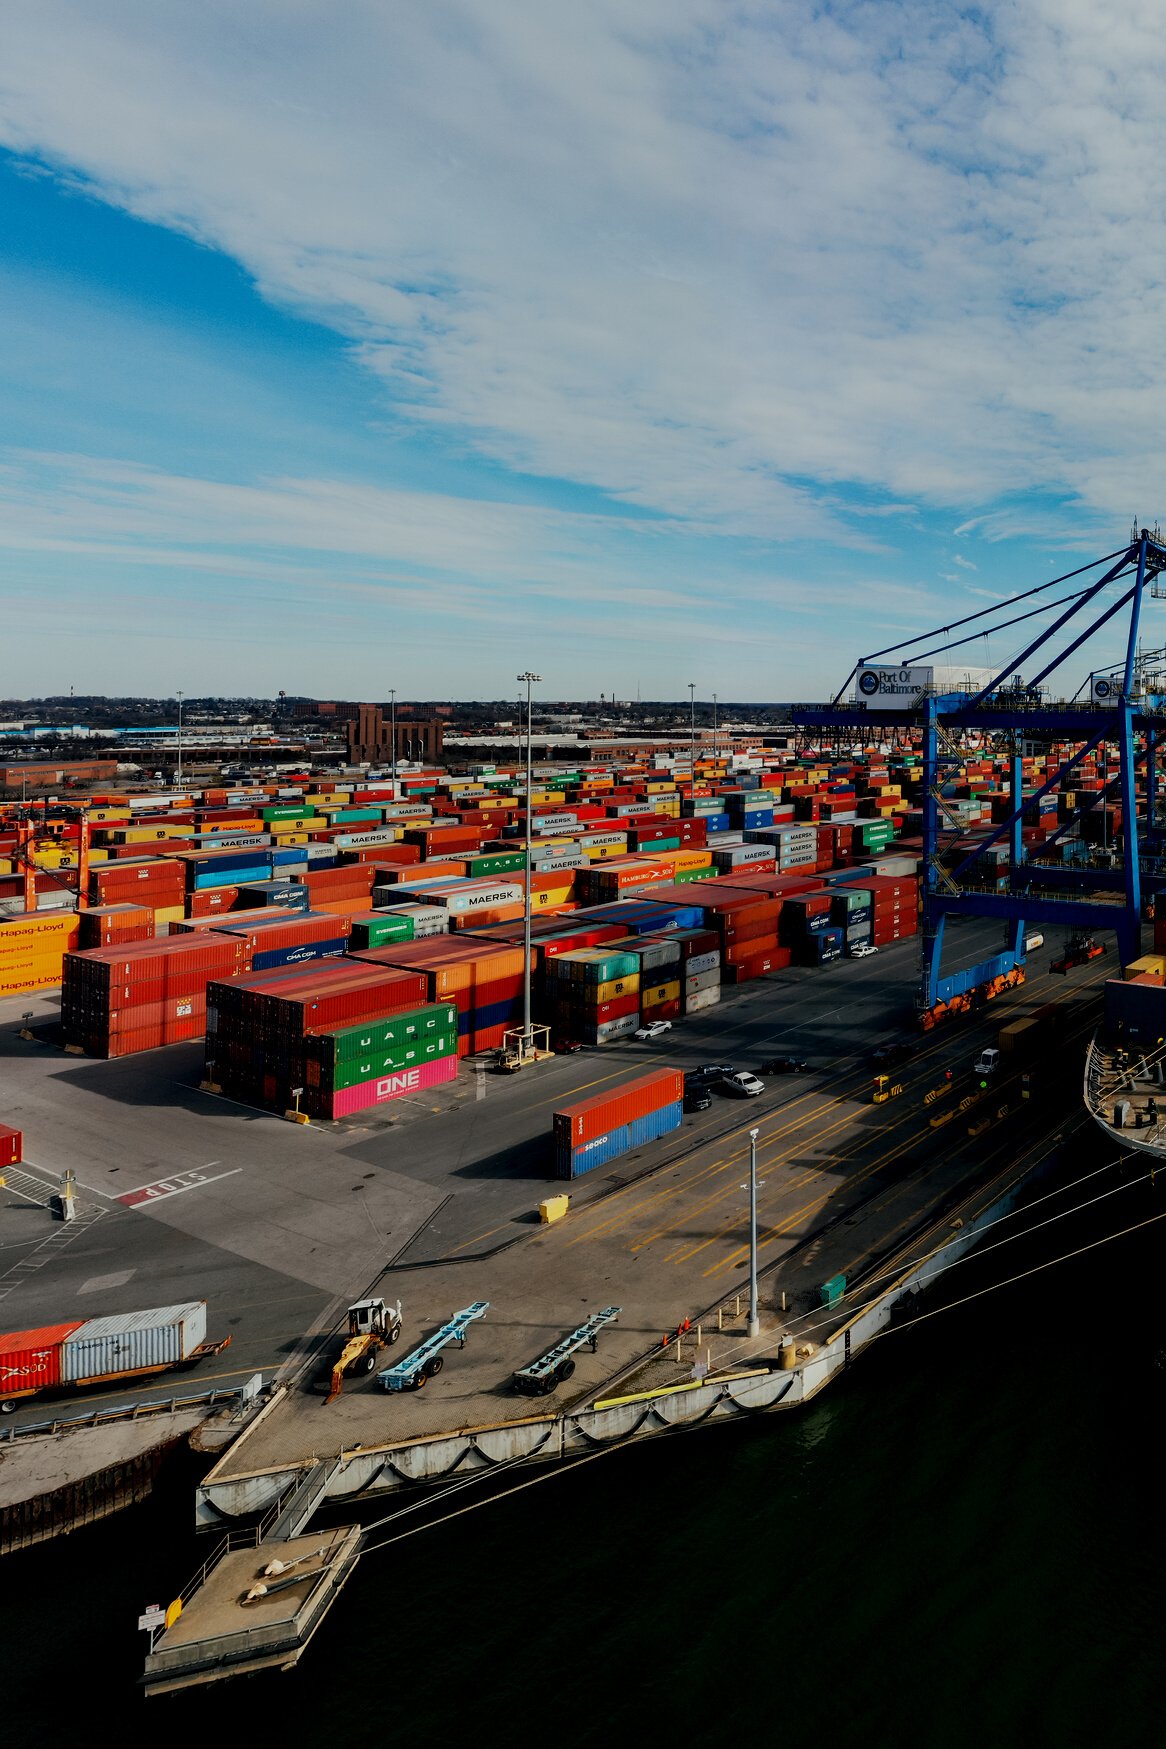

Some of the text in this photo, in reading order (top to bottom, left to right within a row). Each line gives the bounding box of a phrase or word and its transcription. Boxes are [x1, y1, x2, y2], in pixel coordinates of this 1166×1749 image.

[879, 671, 912, 684] Port Of
[879, 683, 921, 695] Baltimore
[545, 817, 571, 825] MAERSK
[351, 834, 387, 844] MAERSK
[592, 837, 622, 845] MAERSK
[791, 832, 813, 840] MAERSK
[221, 838, 262, 847] MAERSK
[791, 843, 813, 851] MAERSK
[744, 850, 771, 859] MAERSK
[790, 855, 813, 864] MAERSK
[551, 860, 583, 869] MAERSK
[621, 873, 650, 884] HAMBURG
[469, 891, 514, 905] MAERSK
[418, 914, 444, 922] MAERSK
[1, 923, 64, 937] Hapag-Lloyd
[0, 944, 33, 954] apag-Lloyd
[286, 953, 301, 961] CMA
[301, 950, 317, 958] CGM
[0, 962, 33, 972] apag-Lloyd
[608, 1019, 635, 1032] MAERSK
[377, 1070, 421, 1097] ONE
[585, 1136, 608, 1152] seaco
[145, 1172, 207, 1198] STOP
